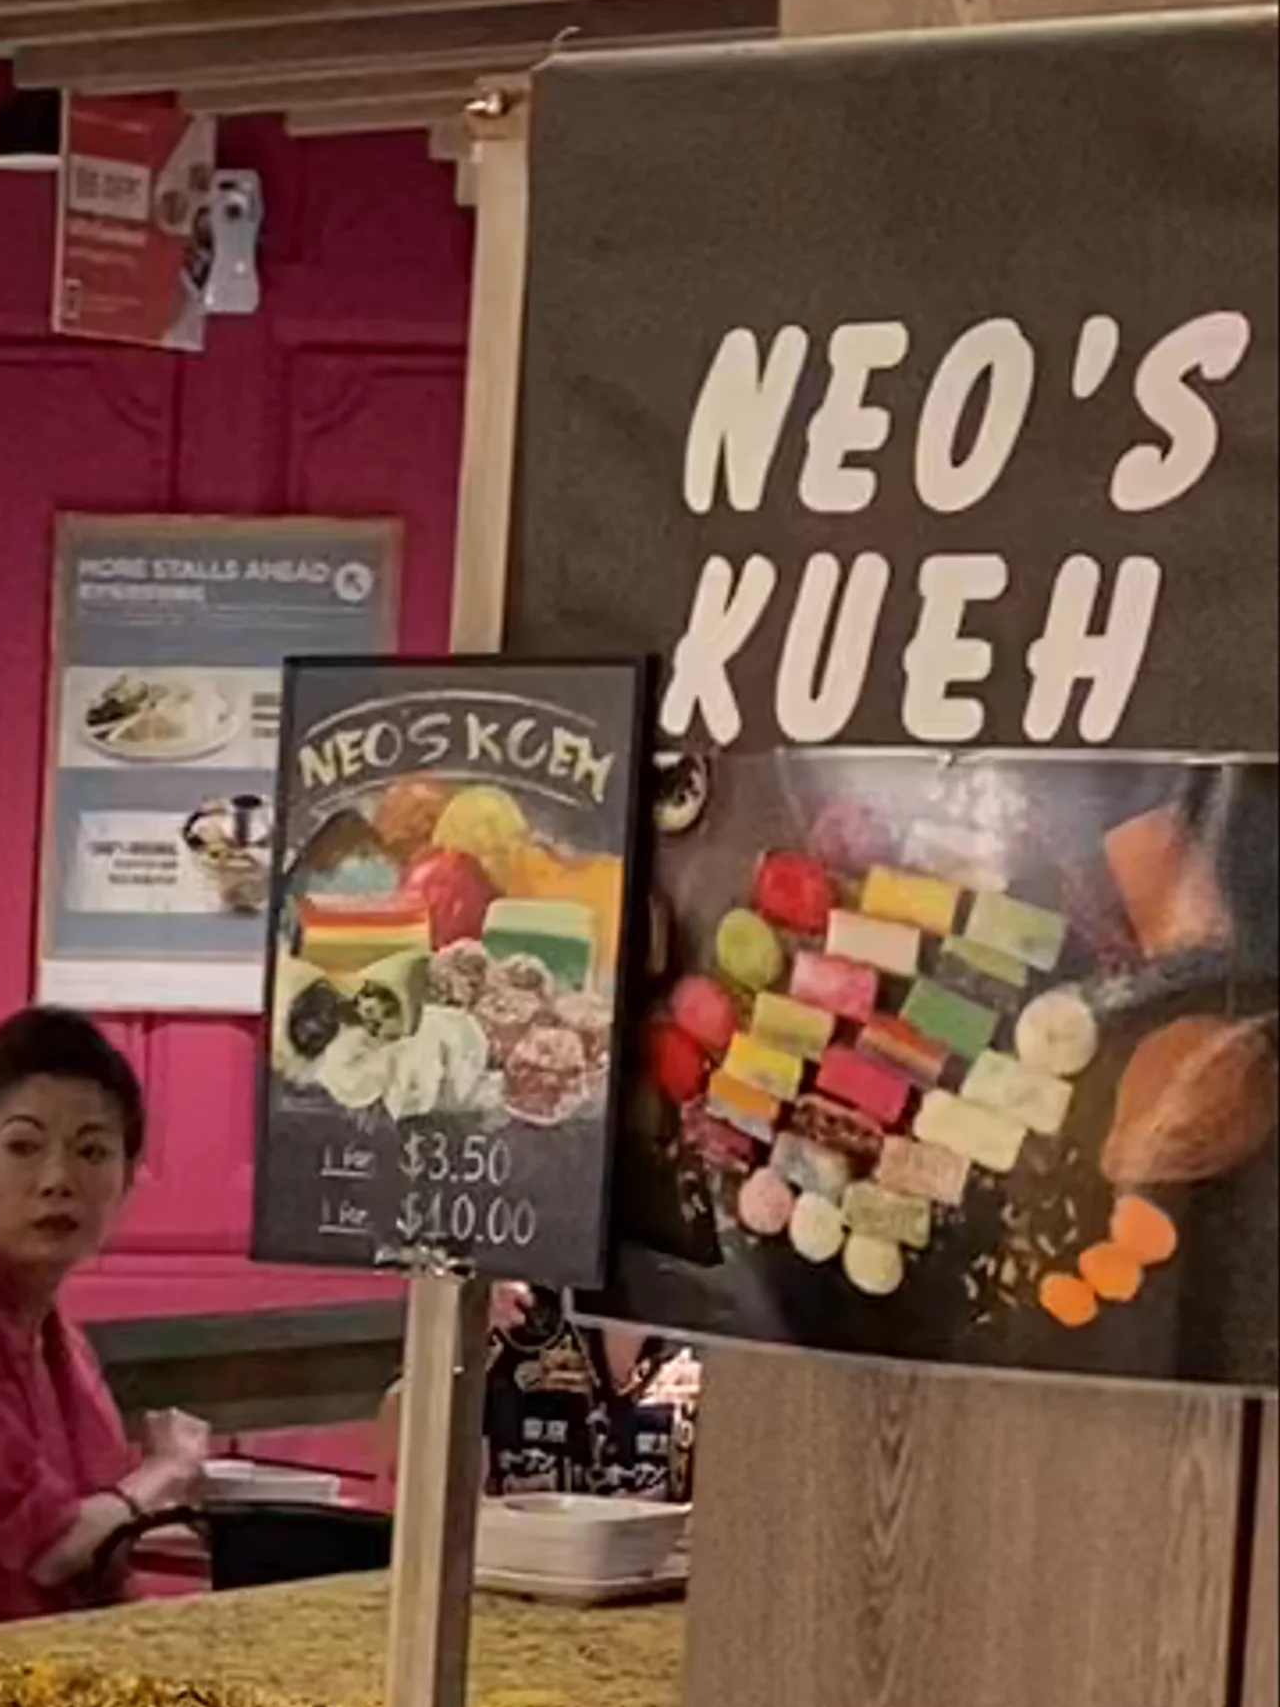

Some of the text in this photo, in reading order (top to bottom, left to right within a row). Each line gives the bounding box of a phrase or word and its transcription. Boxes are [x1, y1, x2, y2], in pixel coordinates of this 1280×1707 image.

[684, 311, 1250, 514] NEO'S
[79, 558, 332, 584] MORE STALLS AHEAD
[660, 551, 1162, 745] KUEH
[298, 708, 452, 788] NEO'S
[399, 1131, 512, 1186] $3.50
[396, 1191, 537, 1246] $10.00
